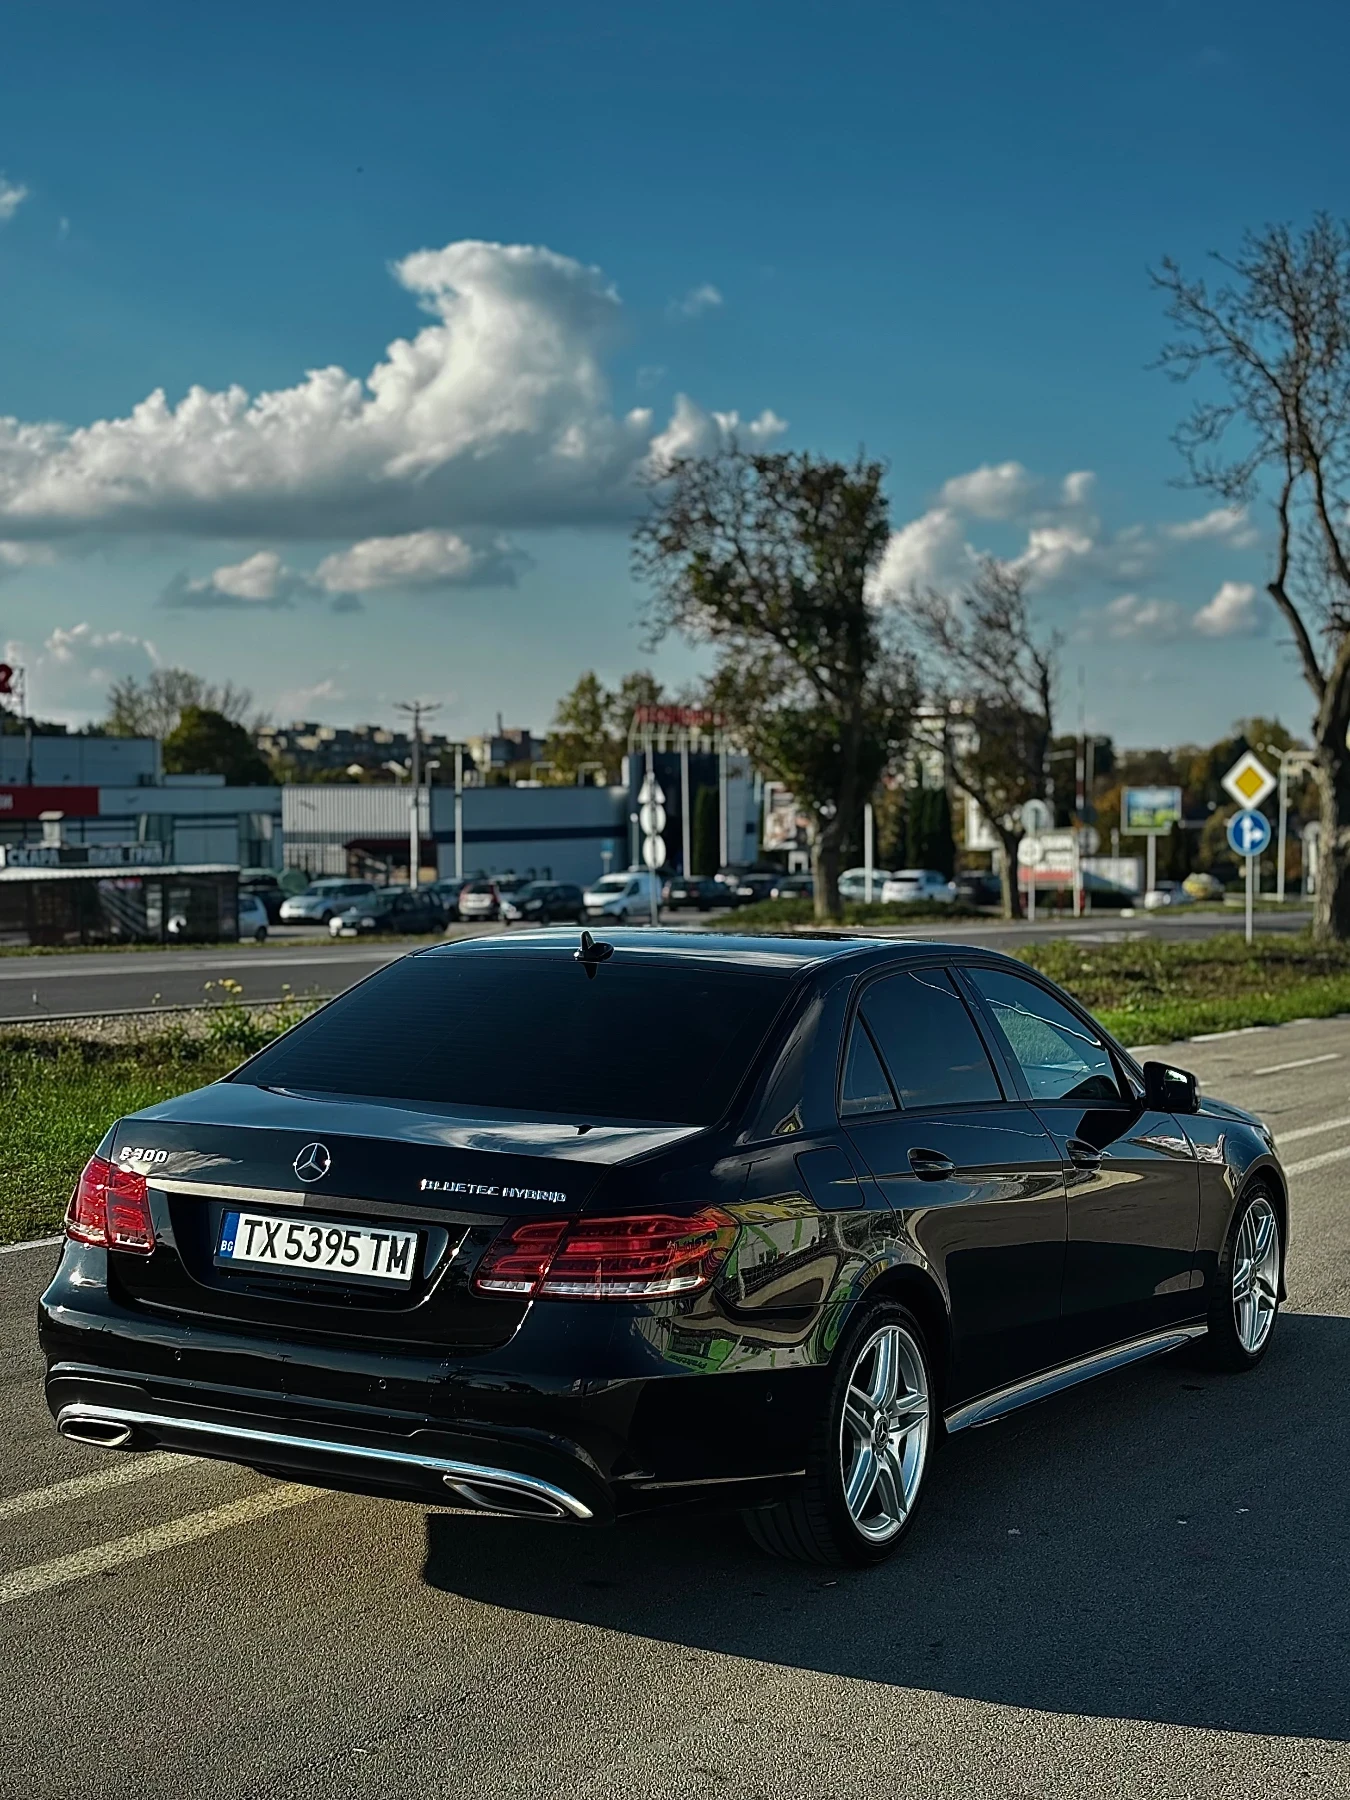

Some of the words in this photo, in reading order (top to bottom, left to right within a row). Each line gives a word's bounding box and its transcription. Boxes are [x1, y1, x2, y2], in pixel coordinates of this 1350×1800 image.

[420, 1178, 499, 1196] BLUETEC
[502, 1186, 567, 1204] HYBRID
[220, 1240, 234, 1252] BG
